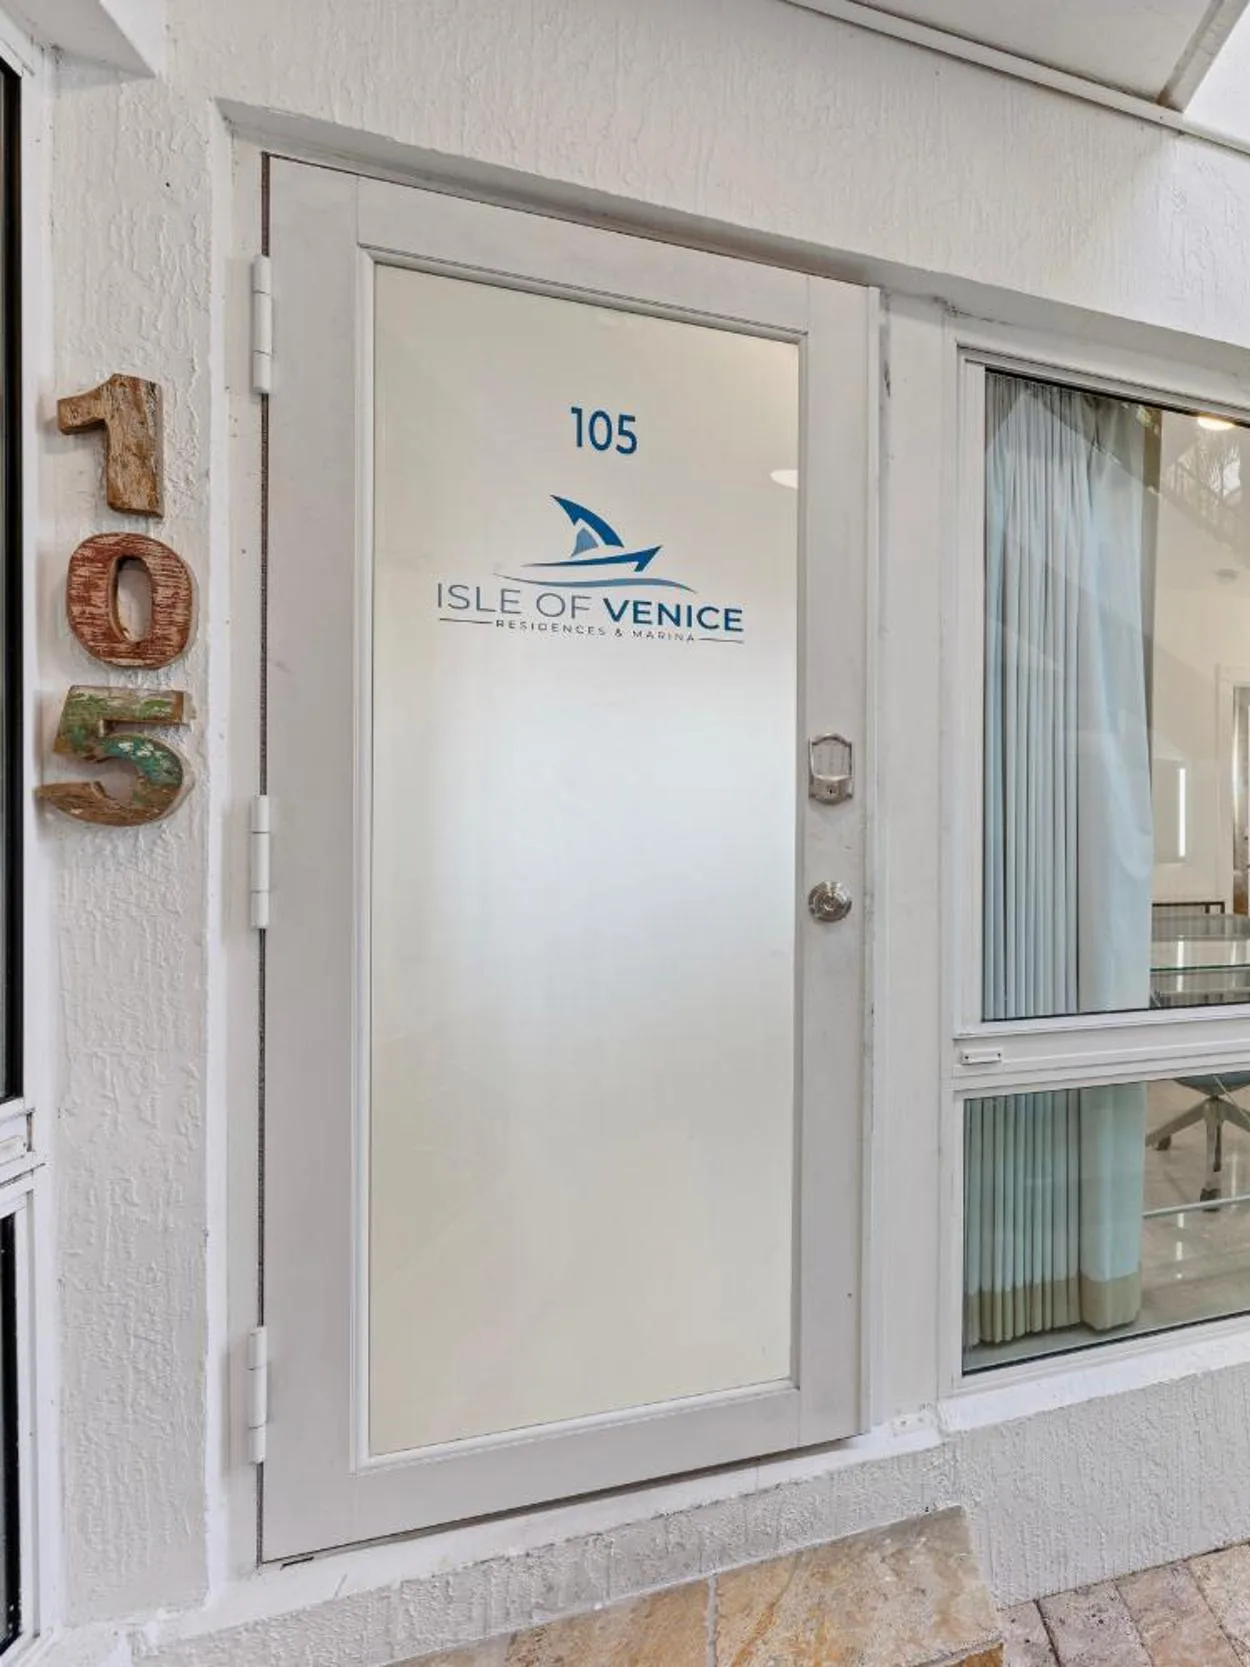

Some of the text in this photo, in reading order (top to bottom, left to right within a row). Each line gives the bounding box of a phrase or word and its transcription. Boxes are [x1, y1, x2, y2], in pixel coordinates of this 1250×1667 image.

[570, 406, 638, 456] 105
[34, 373, 194, 828] 105
[437, 583, 744, 632] ISLE OF VENICE
[495, 619, 695, 642] RESIDENCES & MARINA
